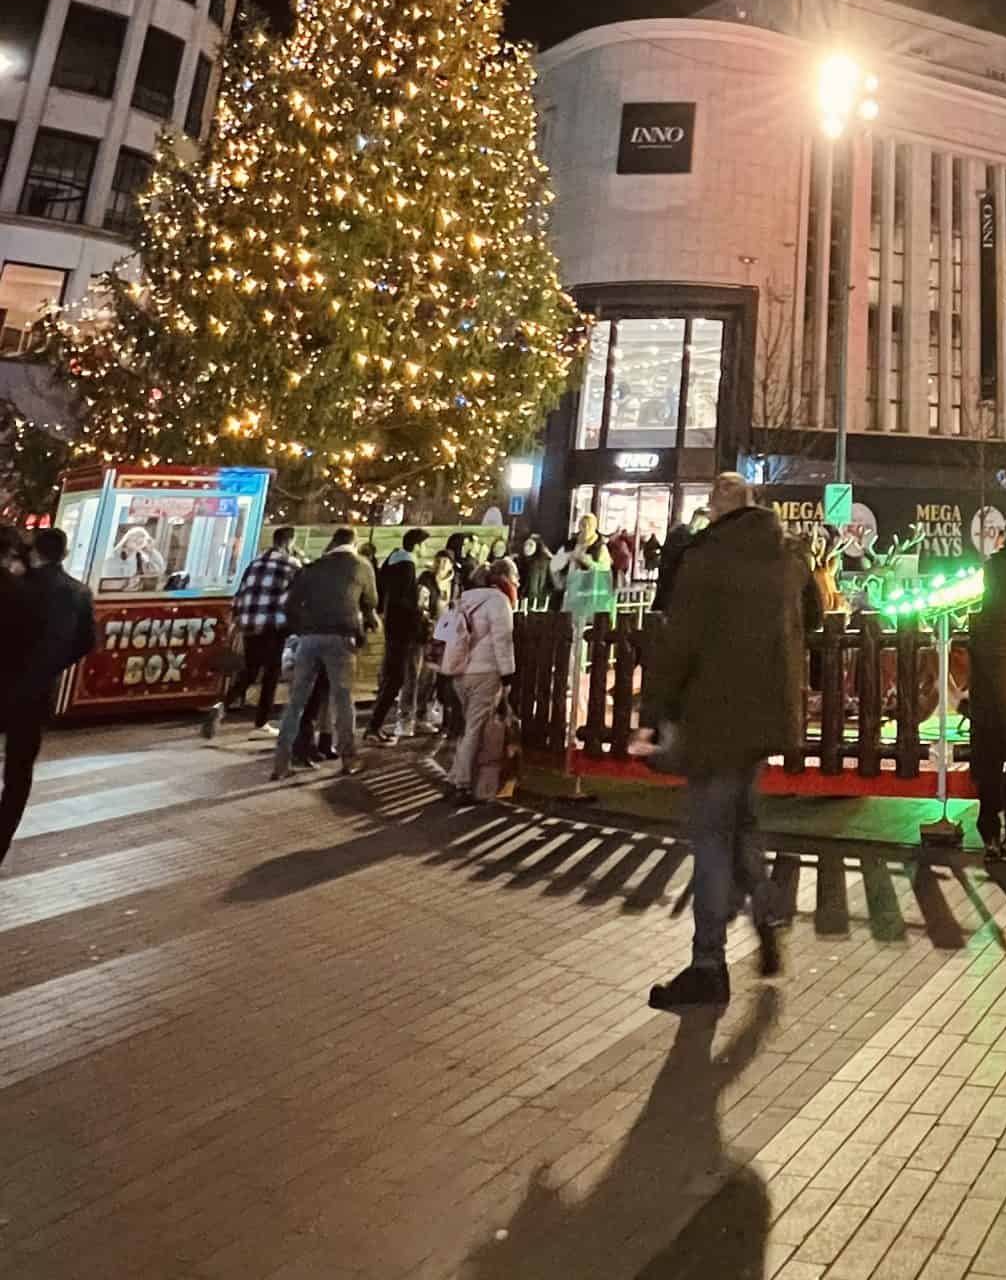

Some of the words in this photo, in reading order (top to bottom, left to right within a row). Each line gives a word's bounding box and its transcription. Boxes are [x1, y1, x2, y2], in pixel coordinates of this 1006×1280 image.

[630, 126, 684, 143] INNO
[983, 204, 993, 248] INNO
[772, 501, 825, 520] MEGA
[916, 504, 962, 521] MEGA
[105, 618, 217, 649] TICKETS
[123, 651, 187, 685] BOX
